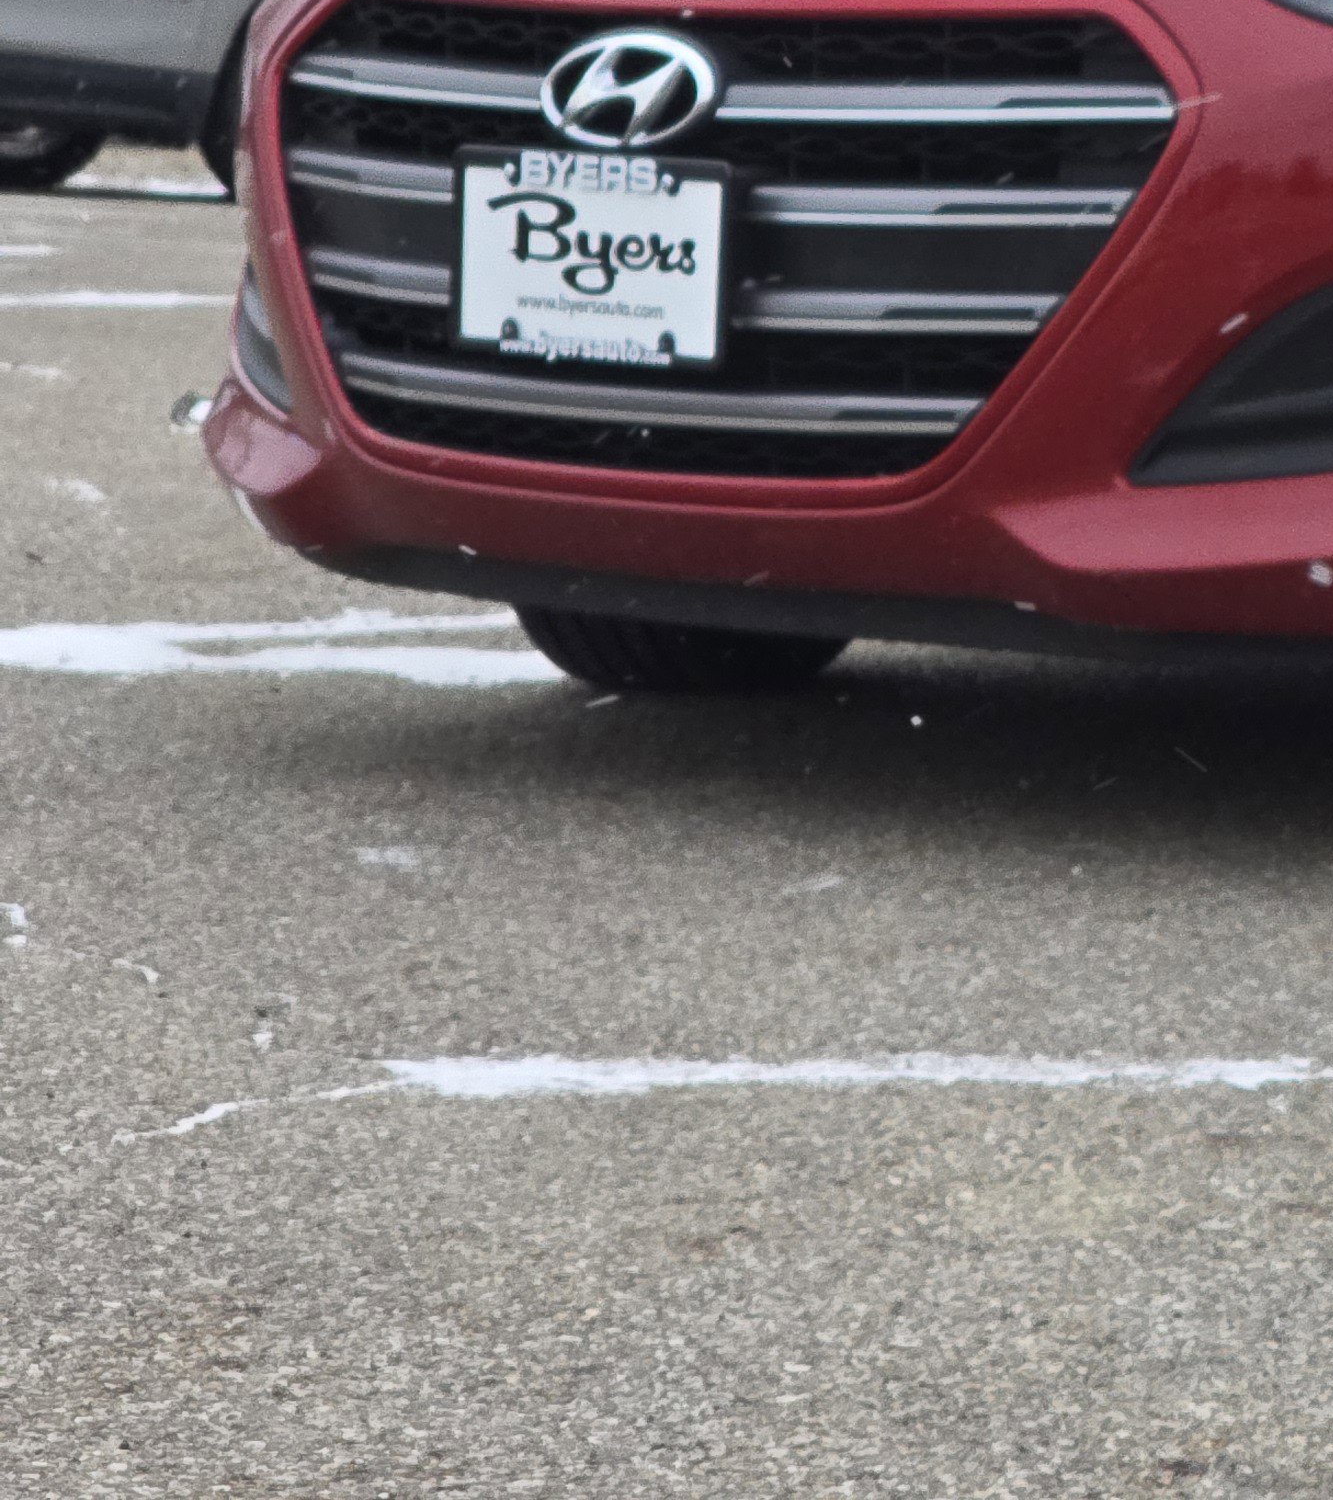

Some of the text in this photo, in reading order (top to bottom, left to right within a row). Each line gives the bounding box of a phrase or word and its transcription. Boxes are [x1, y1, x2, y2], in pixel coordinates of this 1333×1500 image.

[521, 149, 658, 197] BYERS
[487, 191, 697, 296] Byers
[517, 294, 665, 321] www.byersauto.com
